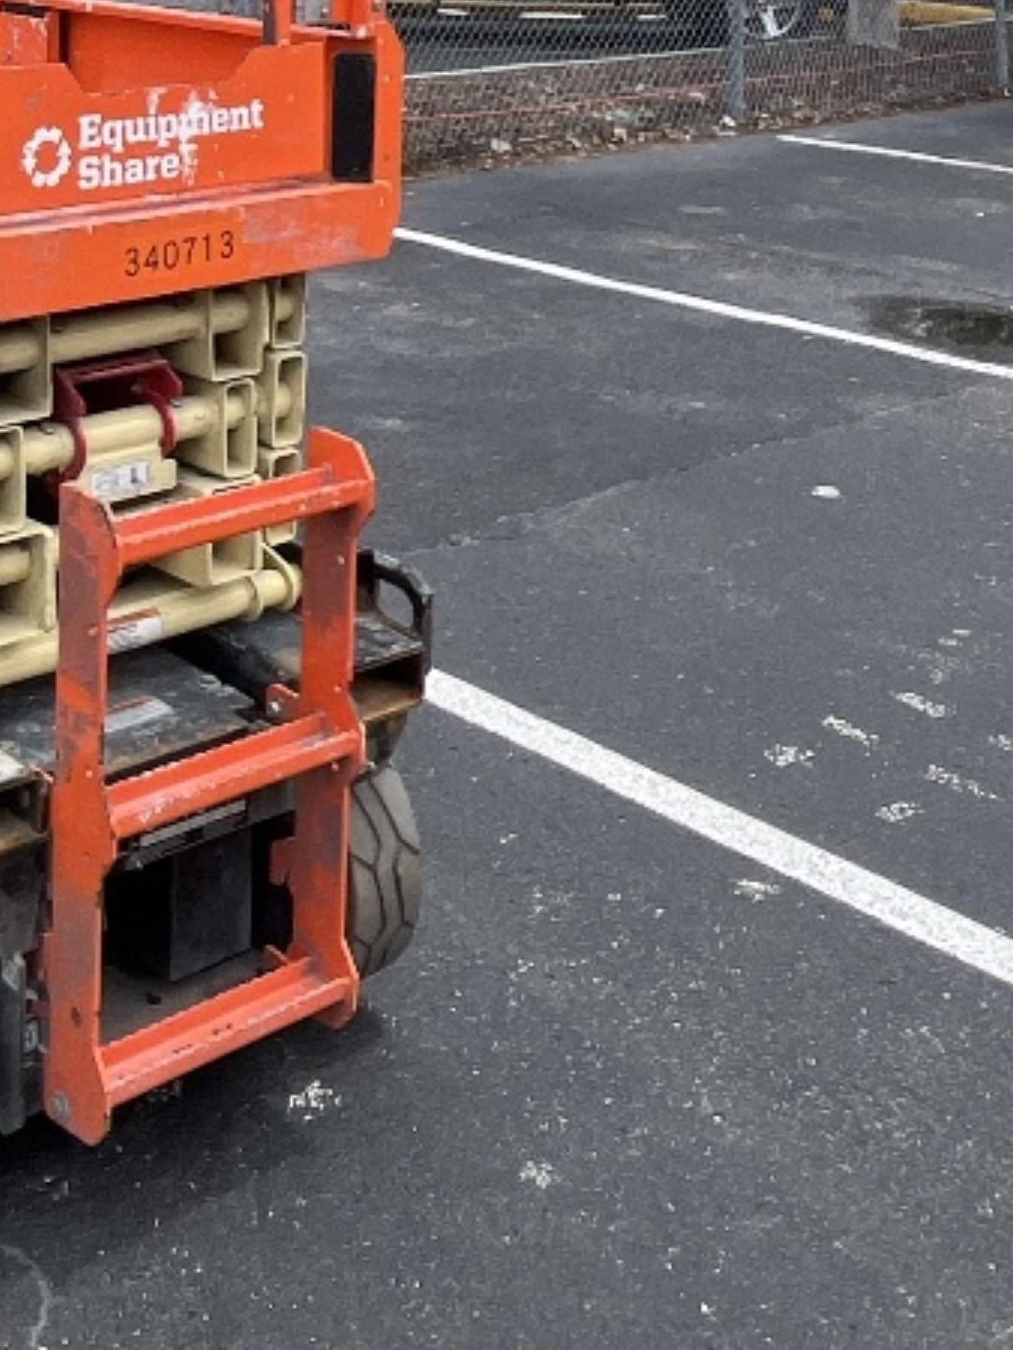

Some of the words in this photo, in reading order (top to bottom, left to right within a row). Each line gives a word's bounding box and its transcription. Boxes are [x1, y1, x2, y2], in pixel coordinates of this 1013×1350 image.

[78, 98, 265, 153] Equipment
[78, 151, 181, 190] Share
[124, 230, 235, 277] 340713
